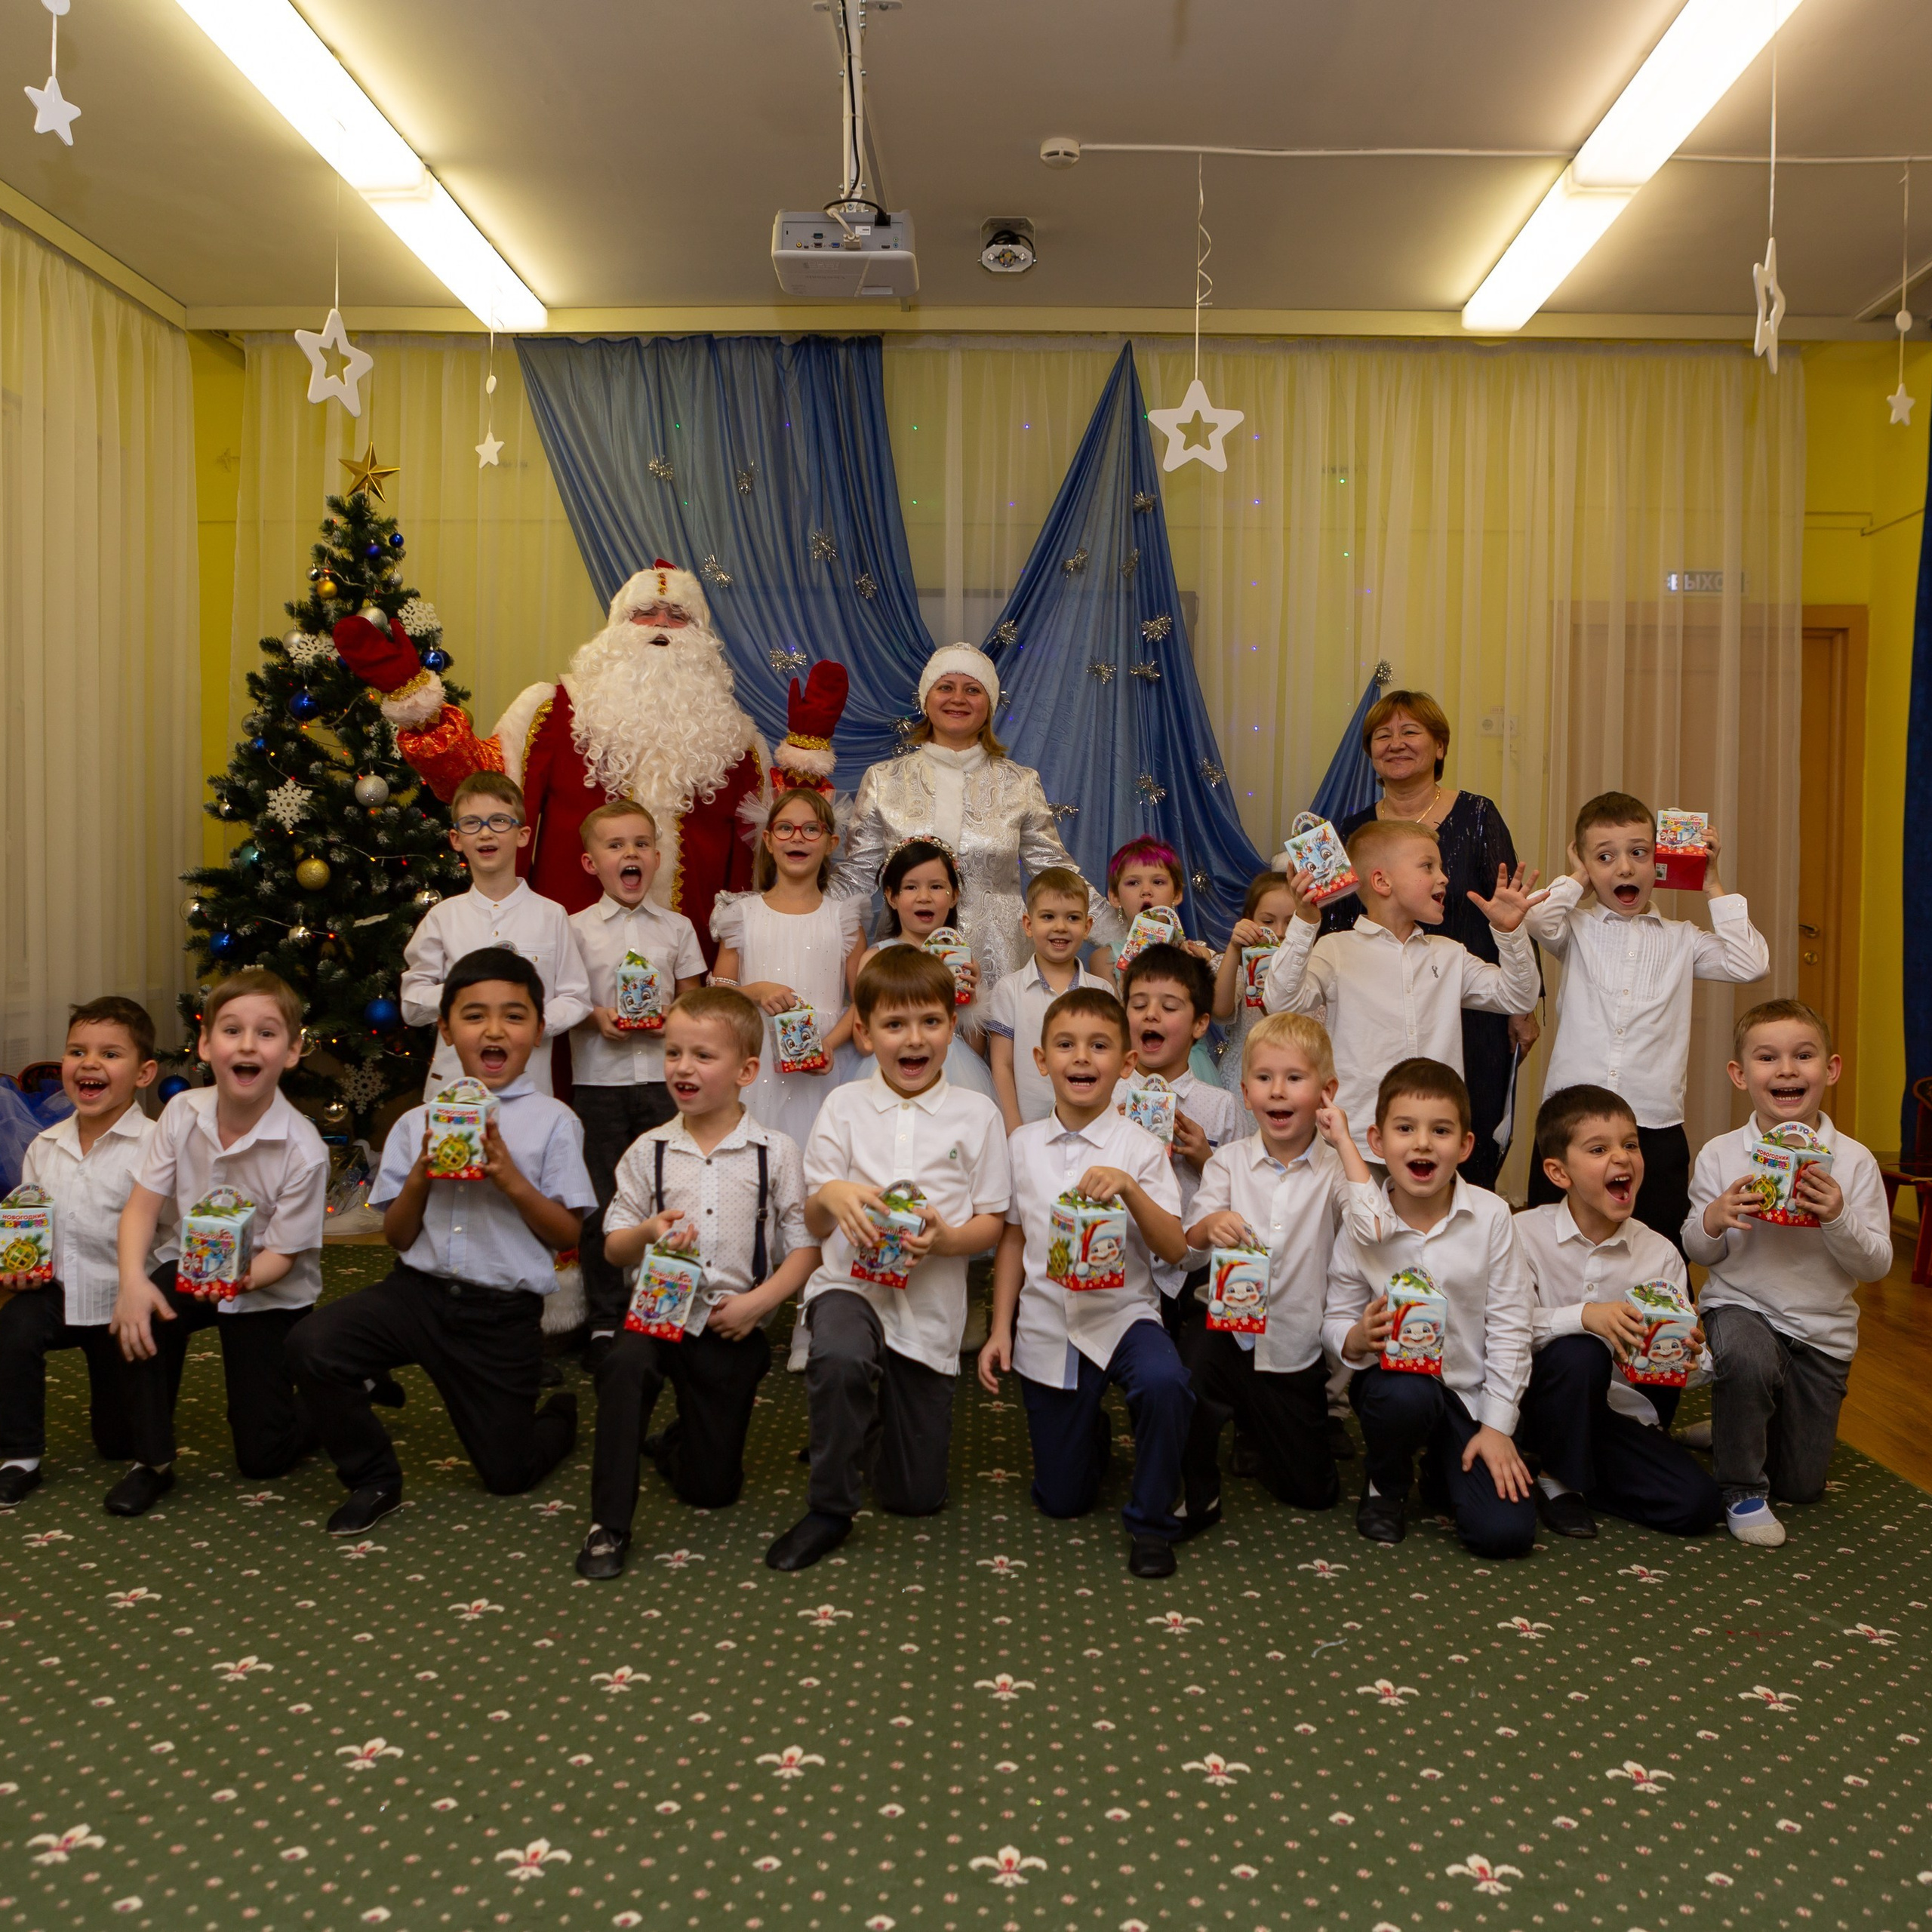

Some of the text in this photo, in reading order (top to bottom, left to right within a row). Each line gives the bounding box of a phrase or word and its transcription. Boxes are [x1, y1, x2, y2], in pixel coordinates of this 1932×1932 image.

[1670, 574, 1724, 591] ВЫХО
[1756, 1147, 1791, 1161] НОВОГОДНИЙ
[1752, 1152, 1792, 1171] СЮРПРИЗ
[2, 1211, 48, 1221] НОВОГОДНИЙ
[0, 1218, 49, 1229] СЮРПРИЗ
